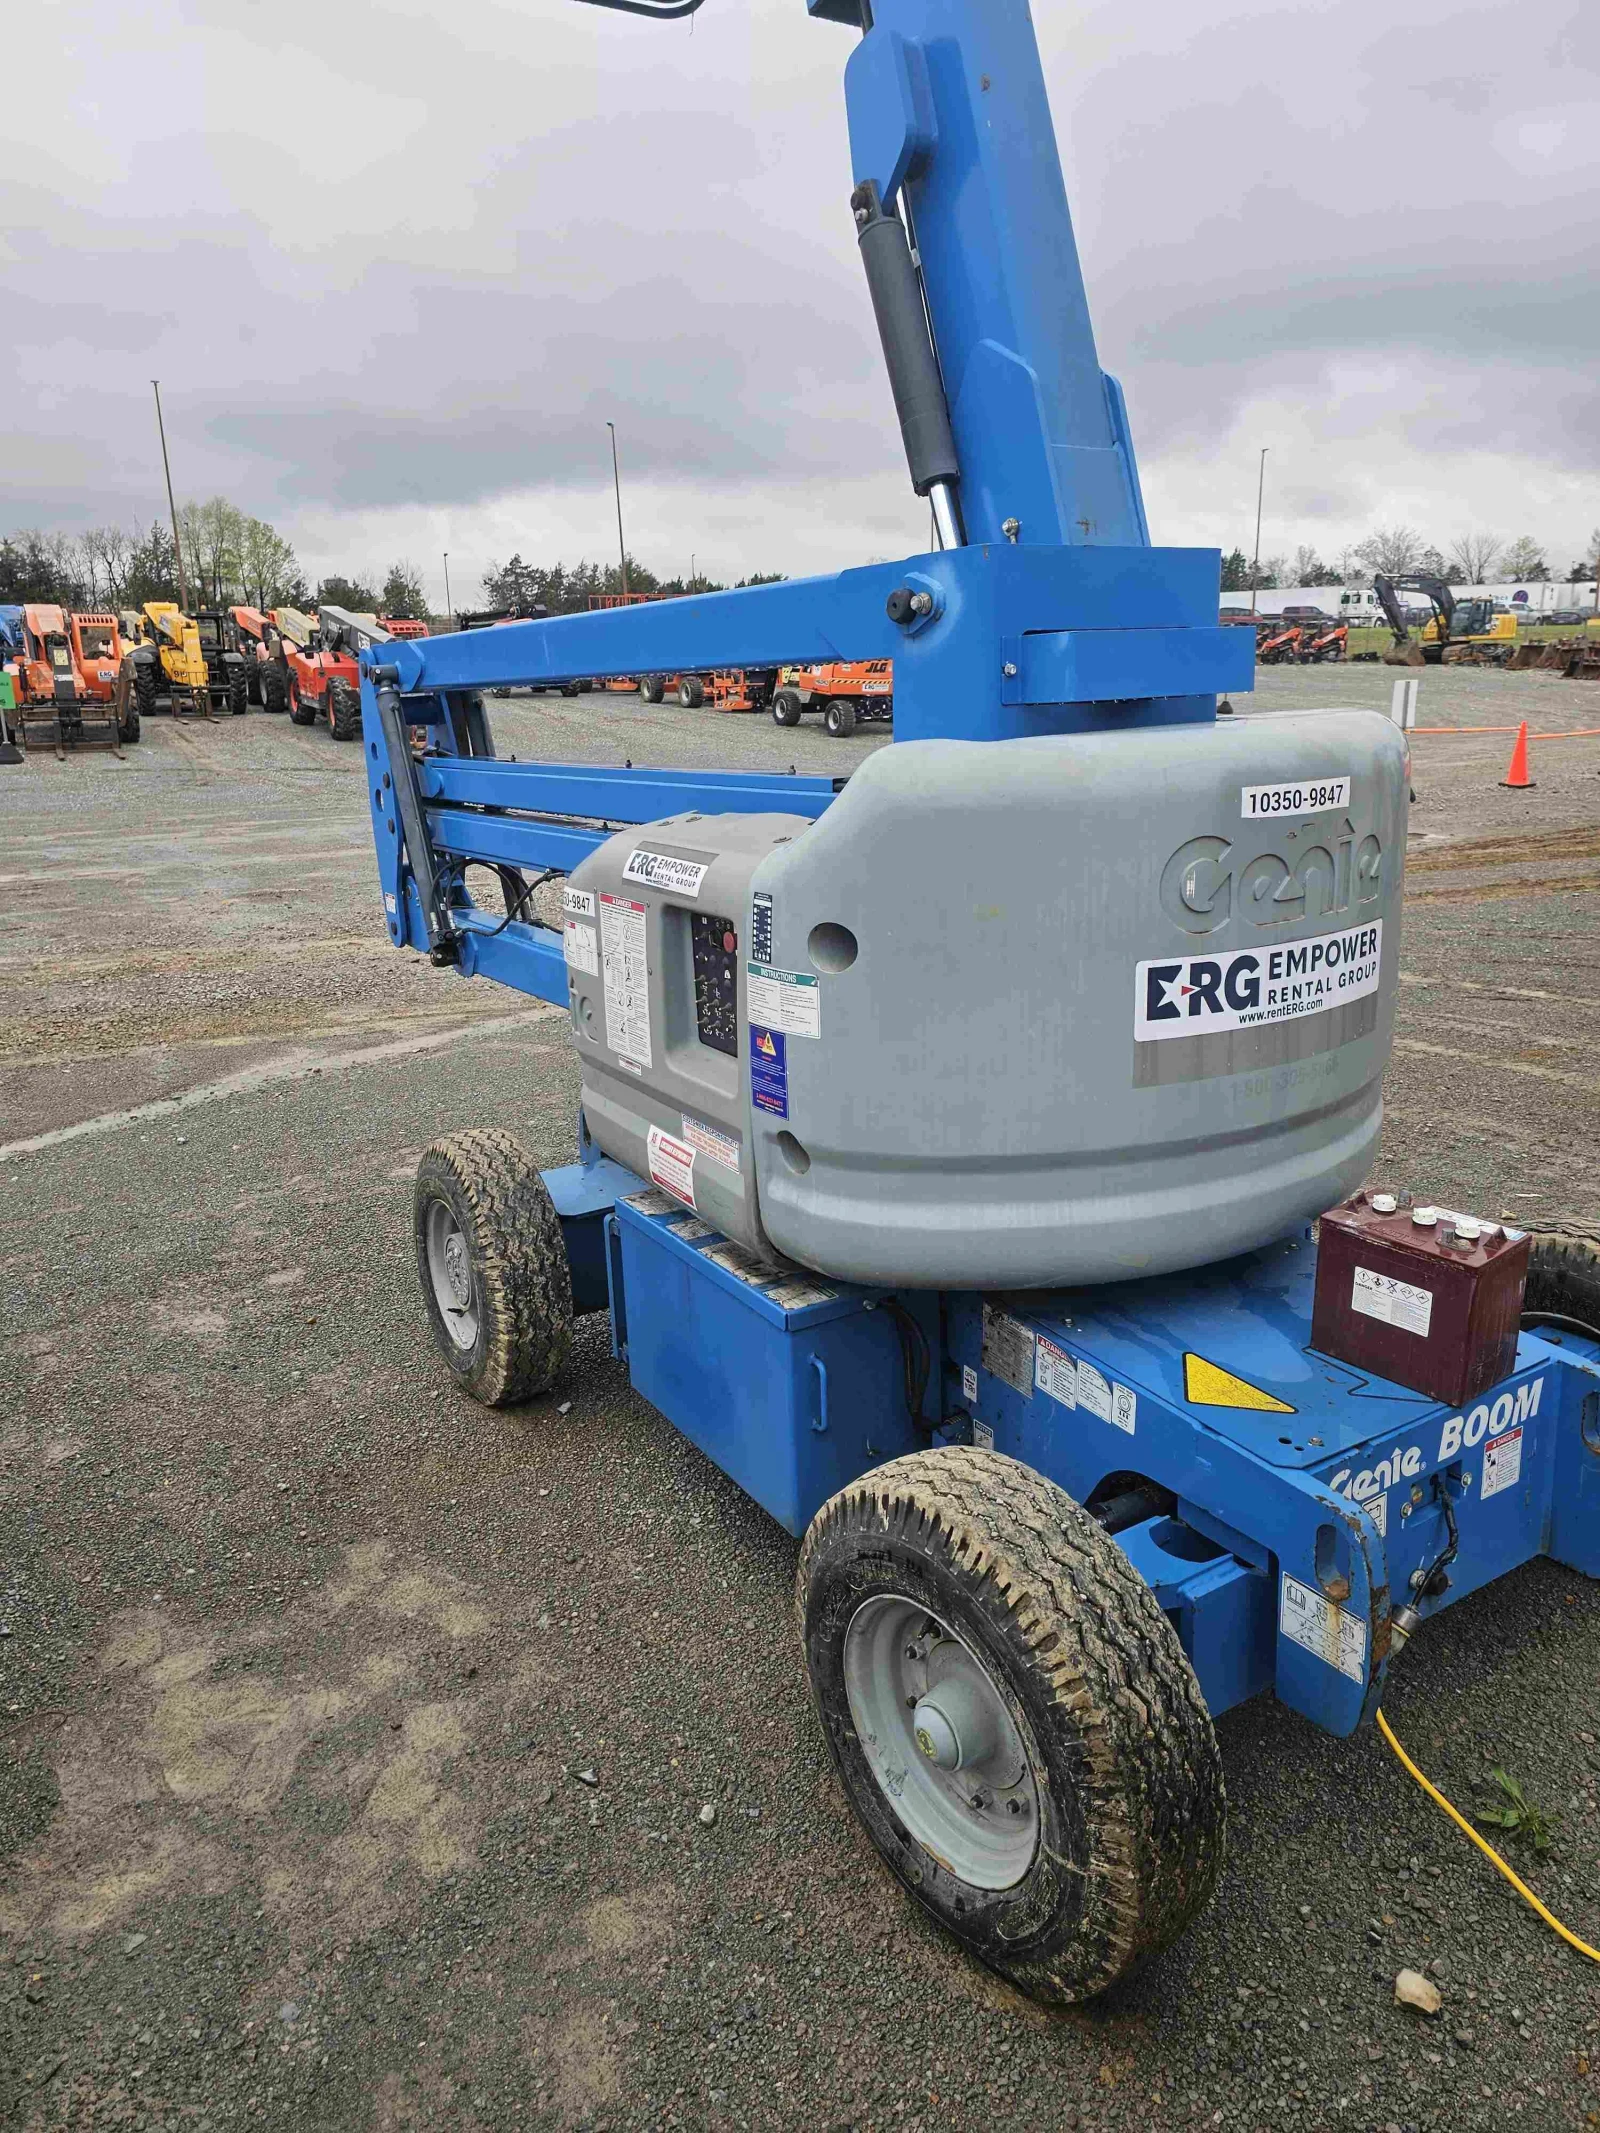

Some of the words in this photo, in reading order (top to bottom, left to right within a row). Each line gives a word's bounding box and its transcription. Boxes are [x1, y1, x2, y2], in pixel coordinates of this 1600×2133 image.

[864, 662, 888, 673] JLG
[1248, 784, 1344, 814] 10350-9847
[628, 852, 658, 877] ERG
[657, 858, 701, 879] EMPOWER
[1159, 818, 1382, 935] Genie
[653, 871, 674, 884] RENTAL
[675, 877, 697, 888] GROUP
[760, 967, 797, 984] INSTRUCTIONS
[1146, 954, 1261, 1022] ERG
[1268, 927, 1377, 981] EMPOWER
[1267, 980, 1332, 1006] RENTAL
[1338, 960, 1377, 989] GROUP
[1238, 998, 1323, 1024] www.rentERG.com
[1354, 1281, 1373, 1291] DANGER
[1329, 1446, 1422, 1501] Genie
[1437, 1376, 1545, 1463] BOOM
[1497, 1432, 1515, 1446] DANGER
